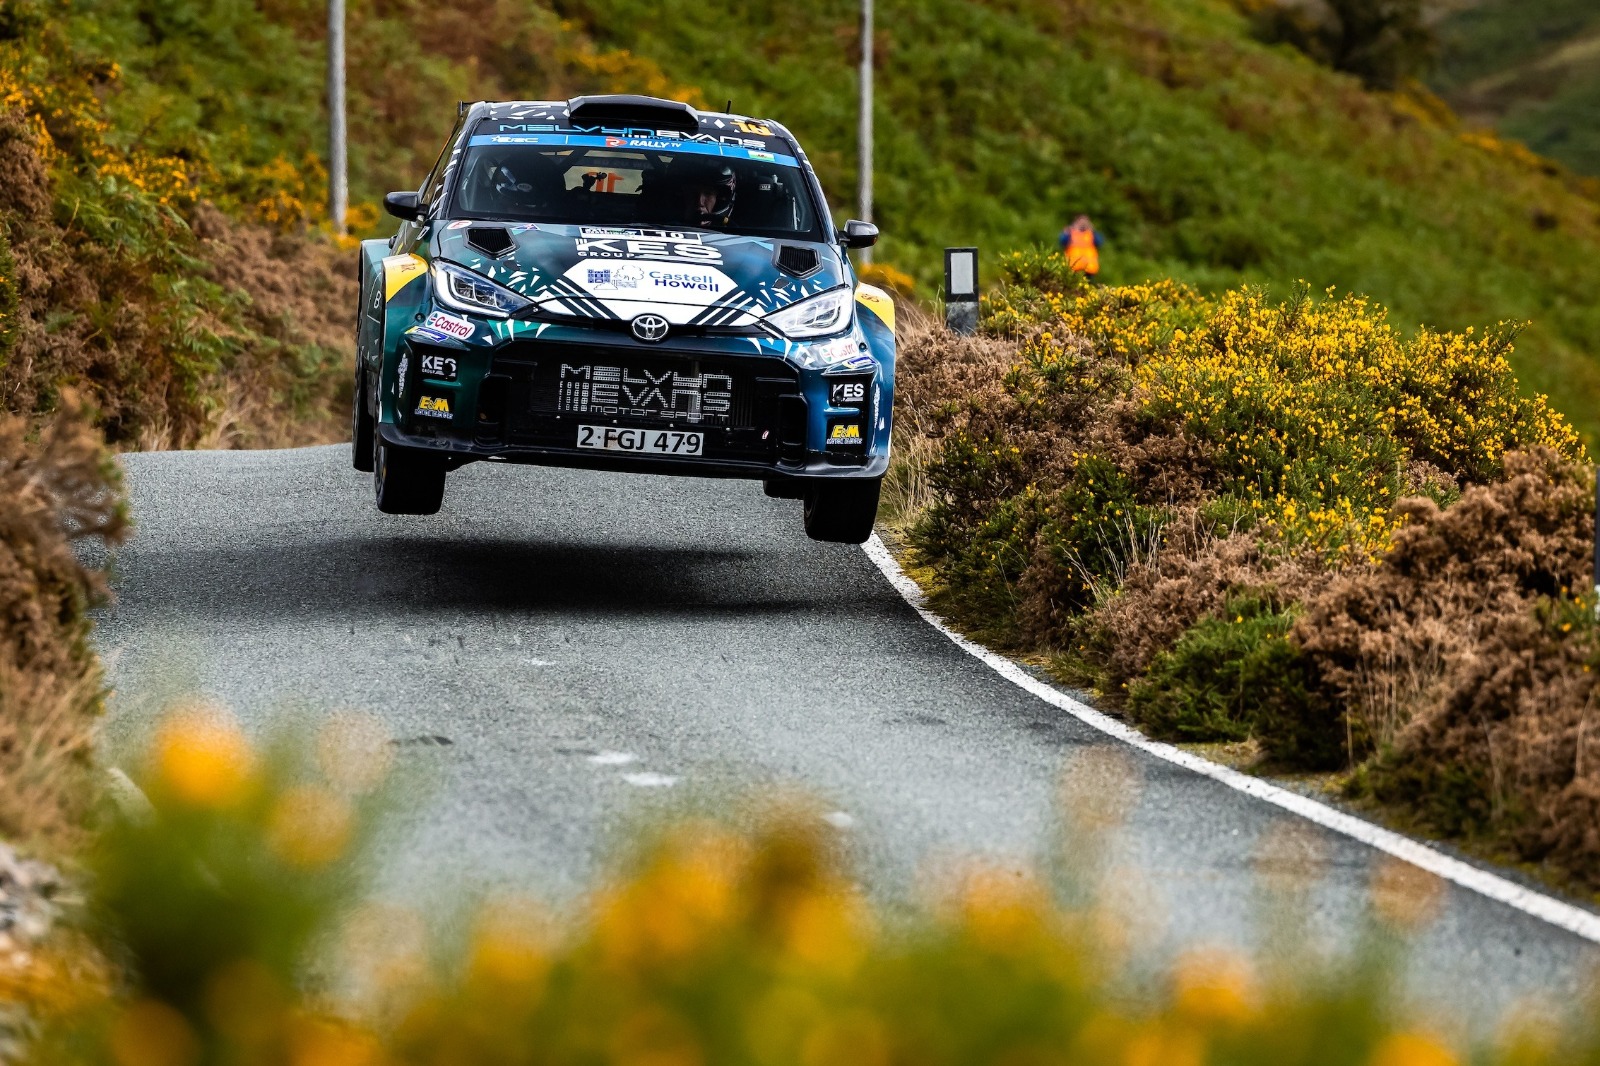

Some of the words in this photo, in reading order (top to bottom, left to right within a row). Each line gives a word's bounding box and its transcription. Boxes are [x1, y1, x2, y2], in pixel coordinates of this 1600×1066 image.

[500, 124, 655, 136] MELVYN
[656, 129, 766, 149] EVANS
[629, 140, 669, 148] RALLY
[655, 231, 684, 239] 10
[575, 239, 722, 259] KES
[649, 271, 713, 284] Castell
[654, 278, 719, 292] Howell
[434, 316, 473, 337] Castrol
[561, 364, 732, 390] MELVYN
[418, 396, 450, 412] E&M
[592, 383, 731, 412] EVANS
[580, 427, 594, 447] 2
[603, 428, 646, 451] FGJ
[653, 432, 701, 453] 479
[832, 424, 860, 438] E&M
